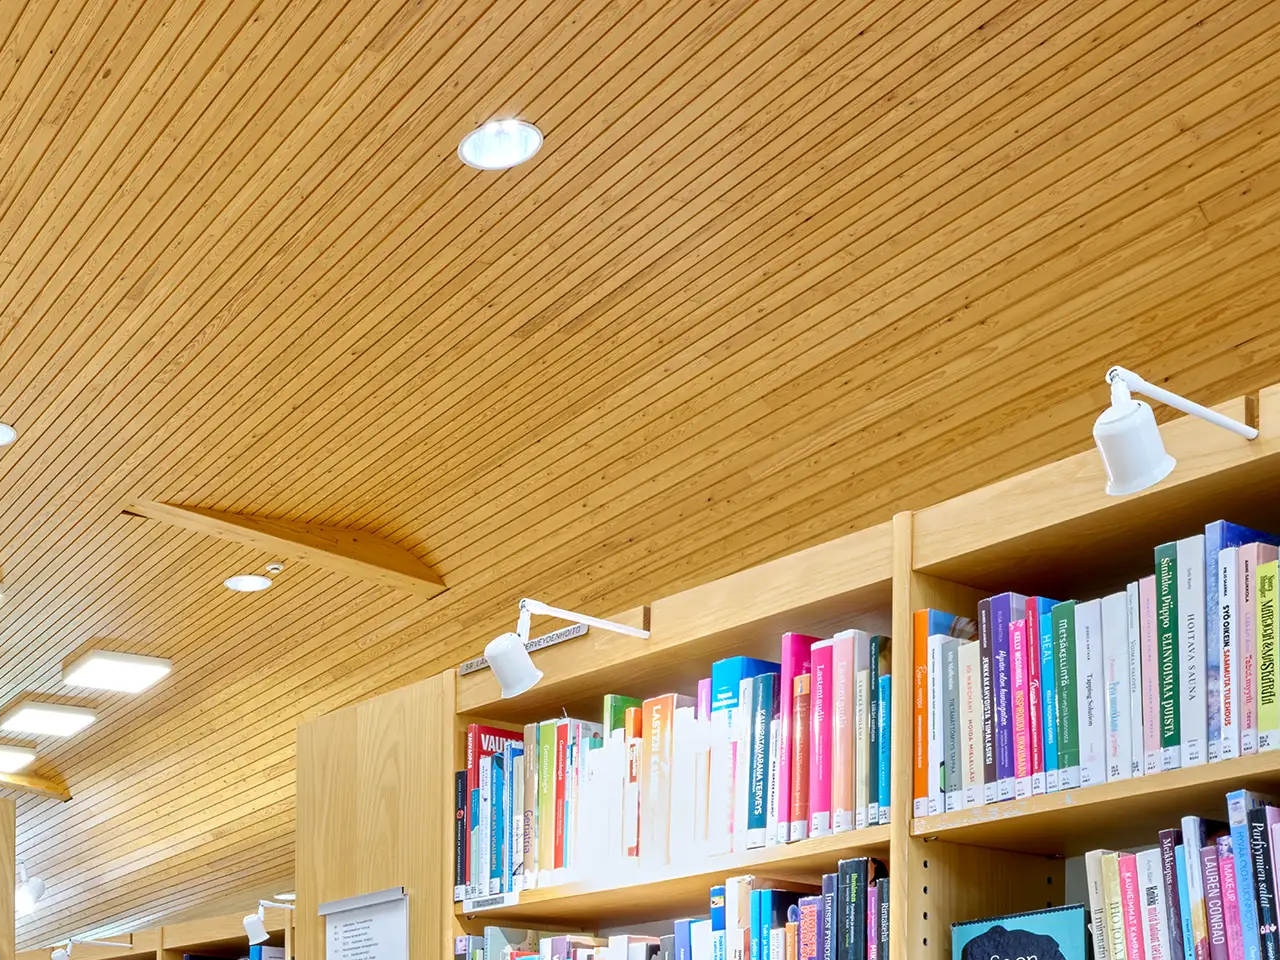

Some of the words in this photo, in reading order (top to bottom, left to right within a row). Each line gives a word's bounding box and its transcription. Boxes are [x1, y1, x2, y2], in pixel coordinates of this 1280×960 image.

[1160, 557, 1172, 594] Sinikka
[1160, 595, 1172, 628] Piippo
[1222, 604, 1231, 620] SYÖ
[1042, 634, 1053, 665] HEAL
[1186, 613, 1196, 661] HOITAVA
[995, 650, 1009, 671] Hyvän
[999, 672, 1008, 688] olon
[1162, 632, 1174, 698] ELINVOIMAA
[1223, 649, 1232, 688] SAMMUTA
[982, 656, 993, 719] JENKKAKAHVOISTA
[1084, 673, 1094, 699] Tapping
[1188, 665, 1197, 701] SAUNA
[998, 689, 1010, 727] kuningatar
[1015, 690, 1026, 732] INSPIROIDU
[1224, 688, 1232, 726] TULEHDUS
[651, 704, 663, 752] LASTEN
[756, 709, 766, 778] KAUPPATAVARANA
[985, 720, 994, 764] TIIMALASIKSI
[542, 744, 551, 793] Gerontologia
[1016, 733, 1027, 777] LIIKKUMAAN
[754, 780, 763, 814] TERVEYS
[522, 809, 535, 854] Geriatria
[1162, 837, 1177, 884] Meikkiopas
[1251, 823, 1271, 882] Parfyymien
[850, 873, 859, 902] Ihminen
[1204, 855, 1220, 897] LAUREN
[1222, 863, 1236, 901] MAKE-UP
[1259, 881, 1271, 909] salat
[824, 892, 835, 928] IHMISEN
[1124, 871, 1136, 923] KAUNEIMMAT
[807, 904, 817, 957] IHMISEN
[1208, 900, 1225, 944] CONRAD
